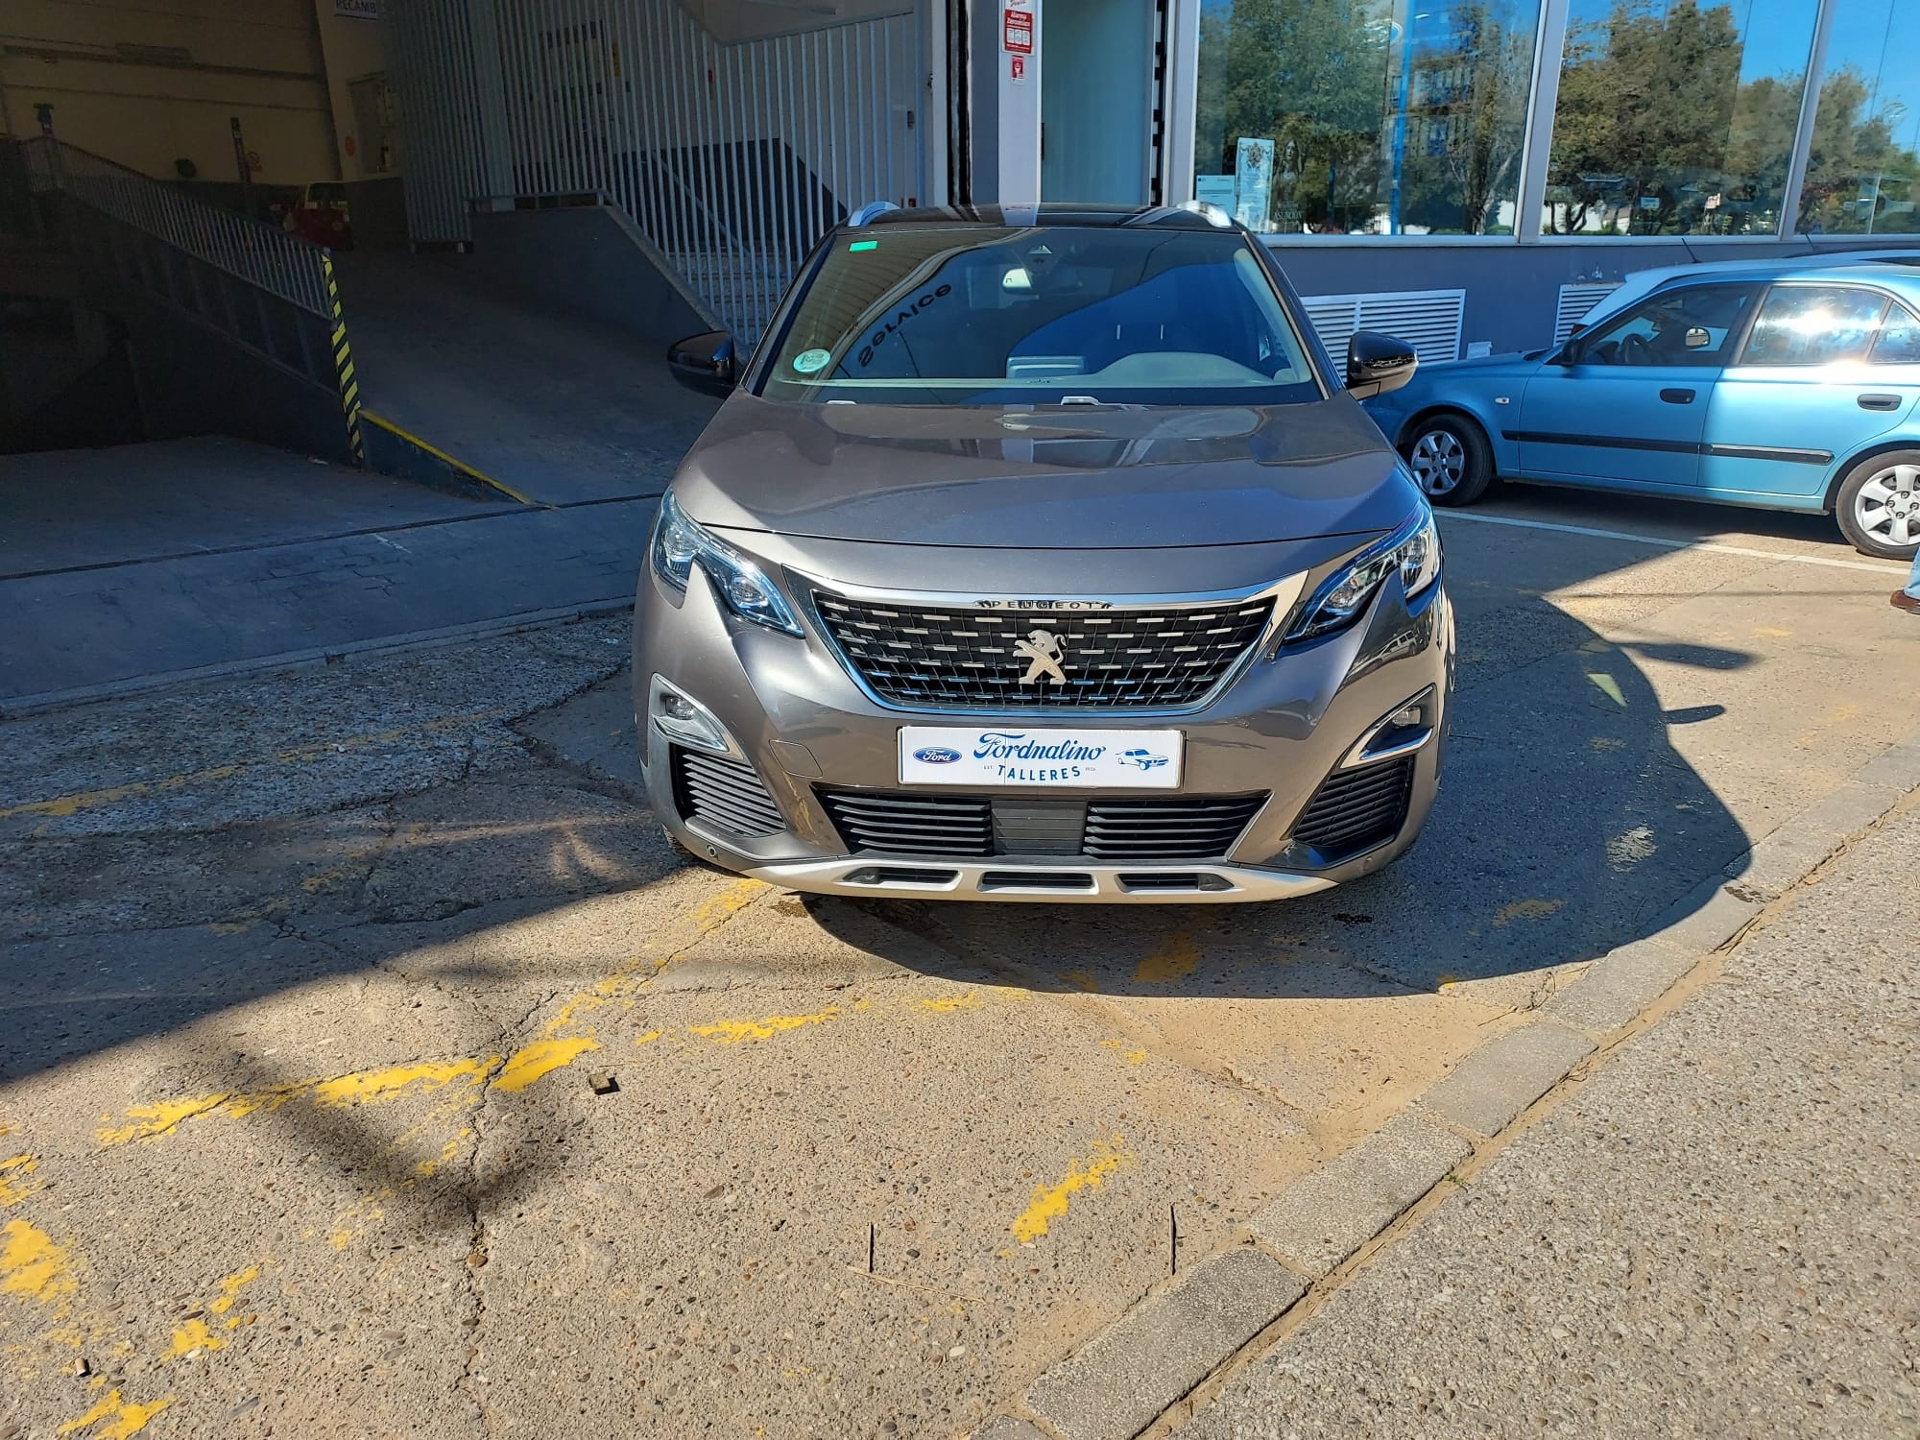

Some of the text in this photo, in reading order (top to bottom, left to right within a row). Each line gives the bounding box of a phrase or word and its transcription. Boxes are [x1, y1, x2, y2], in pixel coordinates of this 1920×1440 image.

[990, 599, 1094, 610] PEUGEOT
[973, 732, 1107, 761] Fordnalino
[998, 764, 1081, 781] TALLERES
